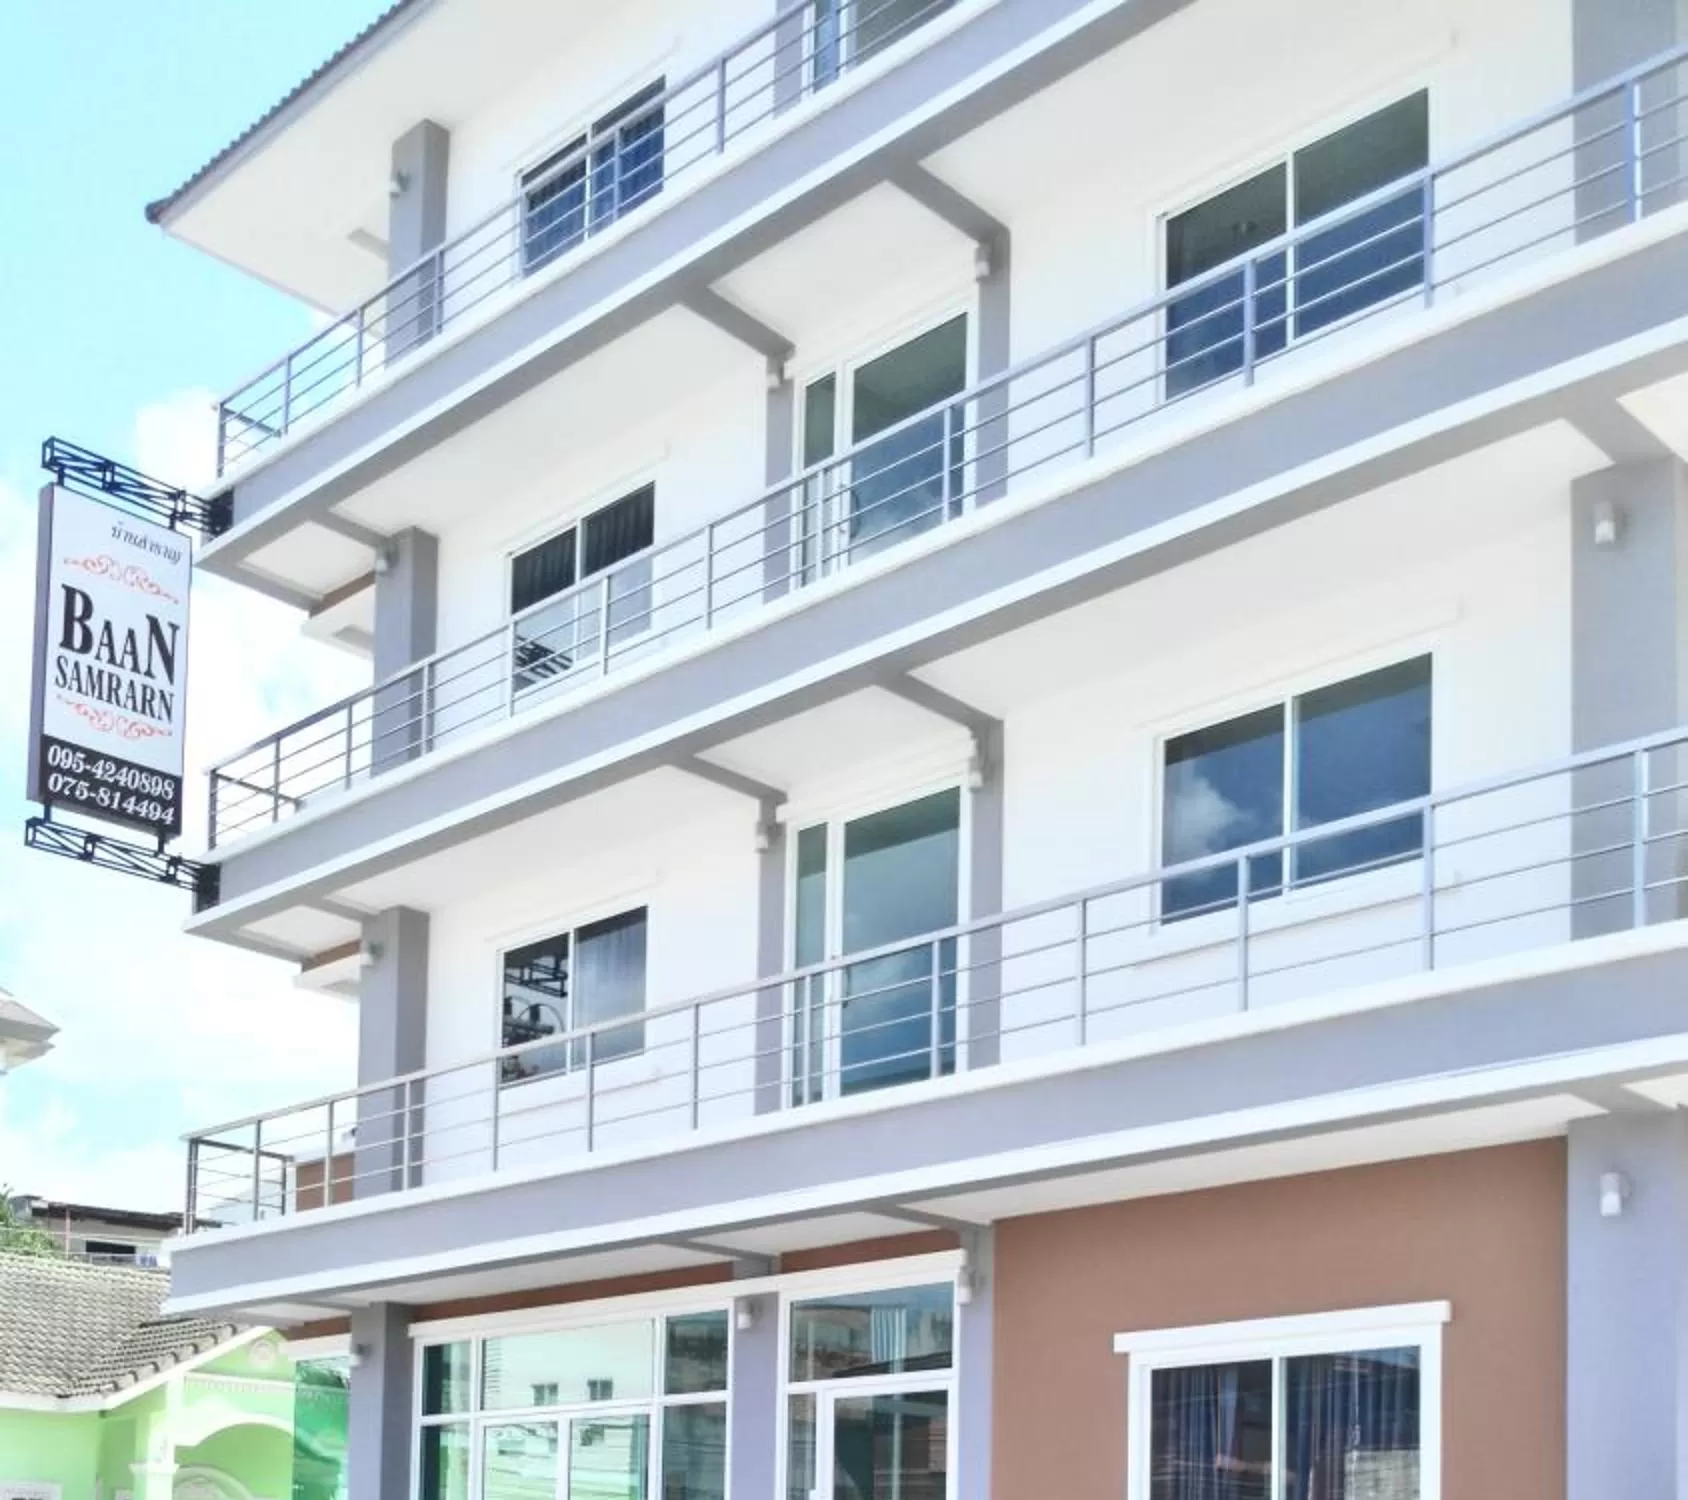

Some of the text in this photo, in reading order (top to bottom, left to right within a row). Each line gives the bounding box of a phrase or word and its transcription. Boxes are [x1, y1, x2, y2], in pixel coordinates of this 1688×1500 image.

[59, 583, 180, 686] BAAN
[55, 654, 175, 723] SAMRARN
[47, 744, 176, 801] 095-4240898
[47, 772, 175, 825] 075-814494
